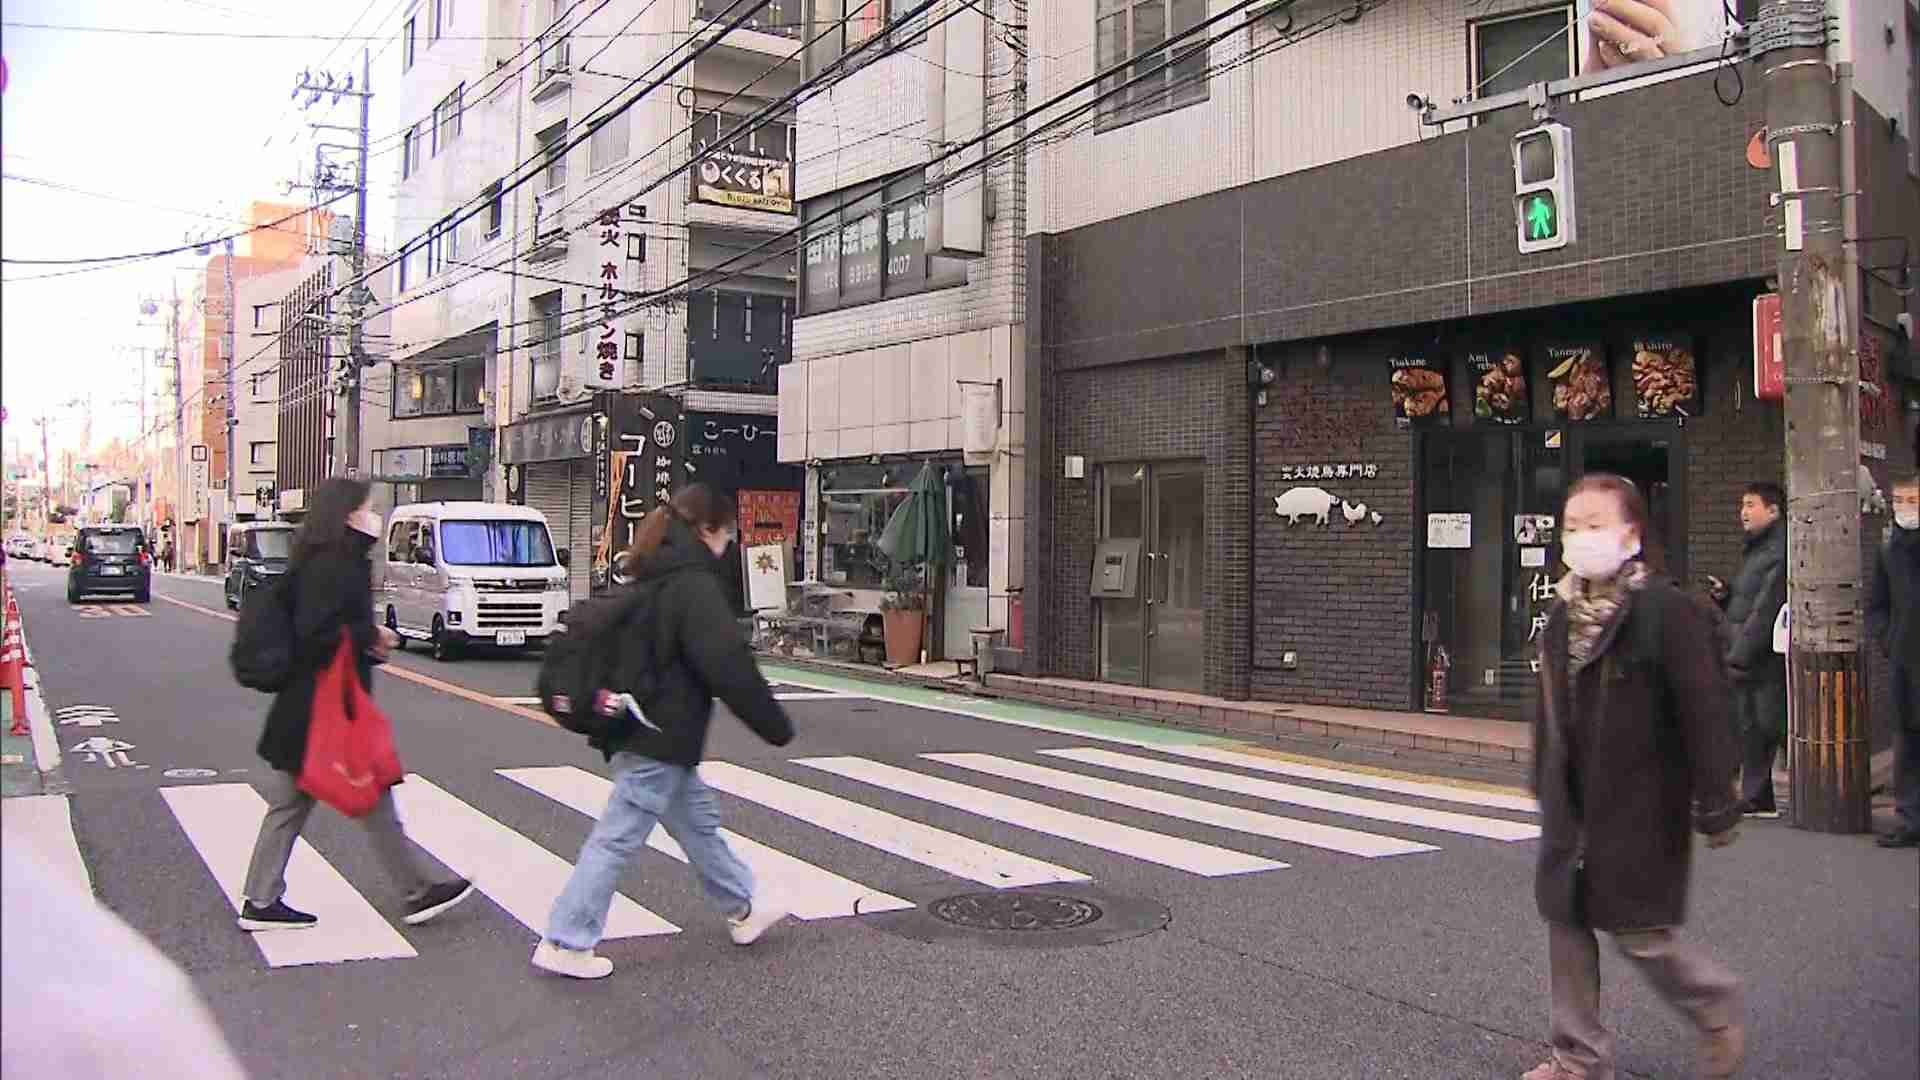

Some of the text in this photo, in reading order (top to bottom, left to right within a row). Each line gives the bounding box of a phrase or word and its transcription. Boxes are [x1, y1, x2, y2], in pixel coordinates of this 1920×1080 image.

[703, 420, 777, 442] こーひー
[620, 433, 646, 545] コーヒー
